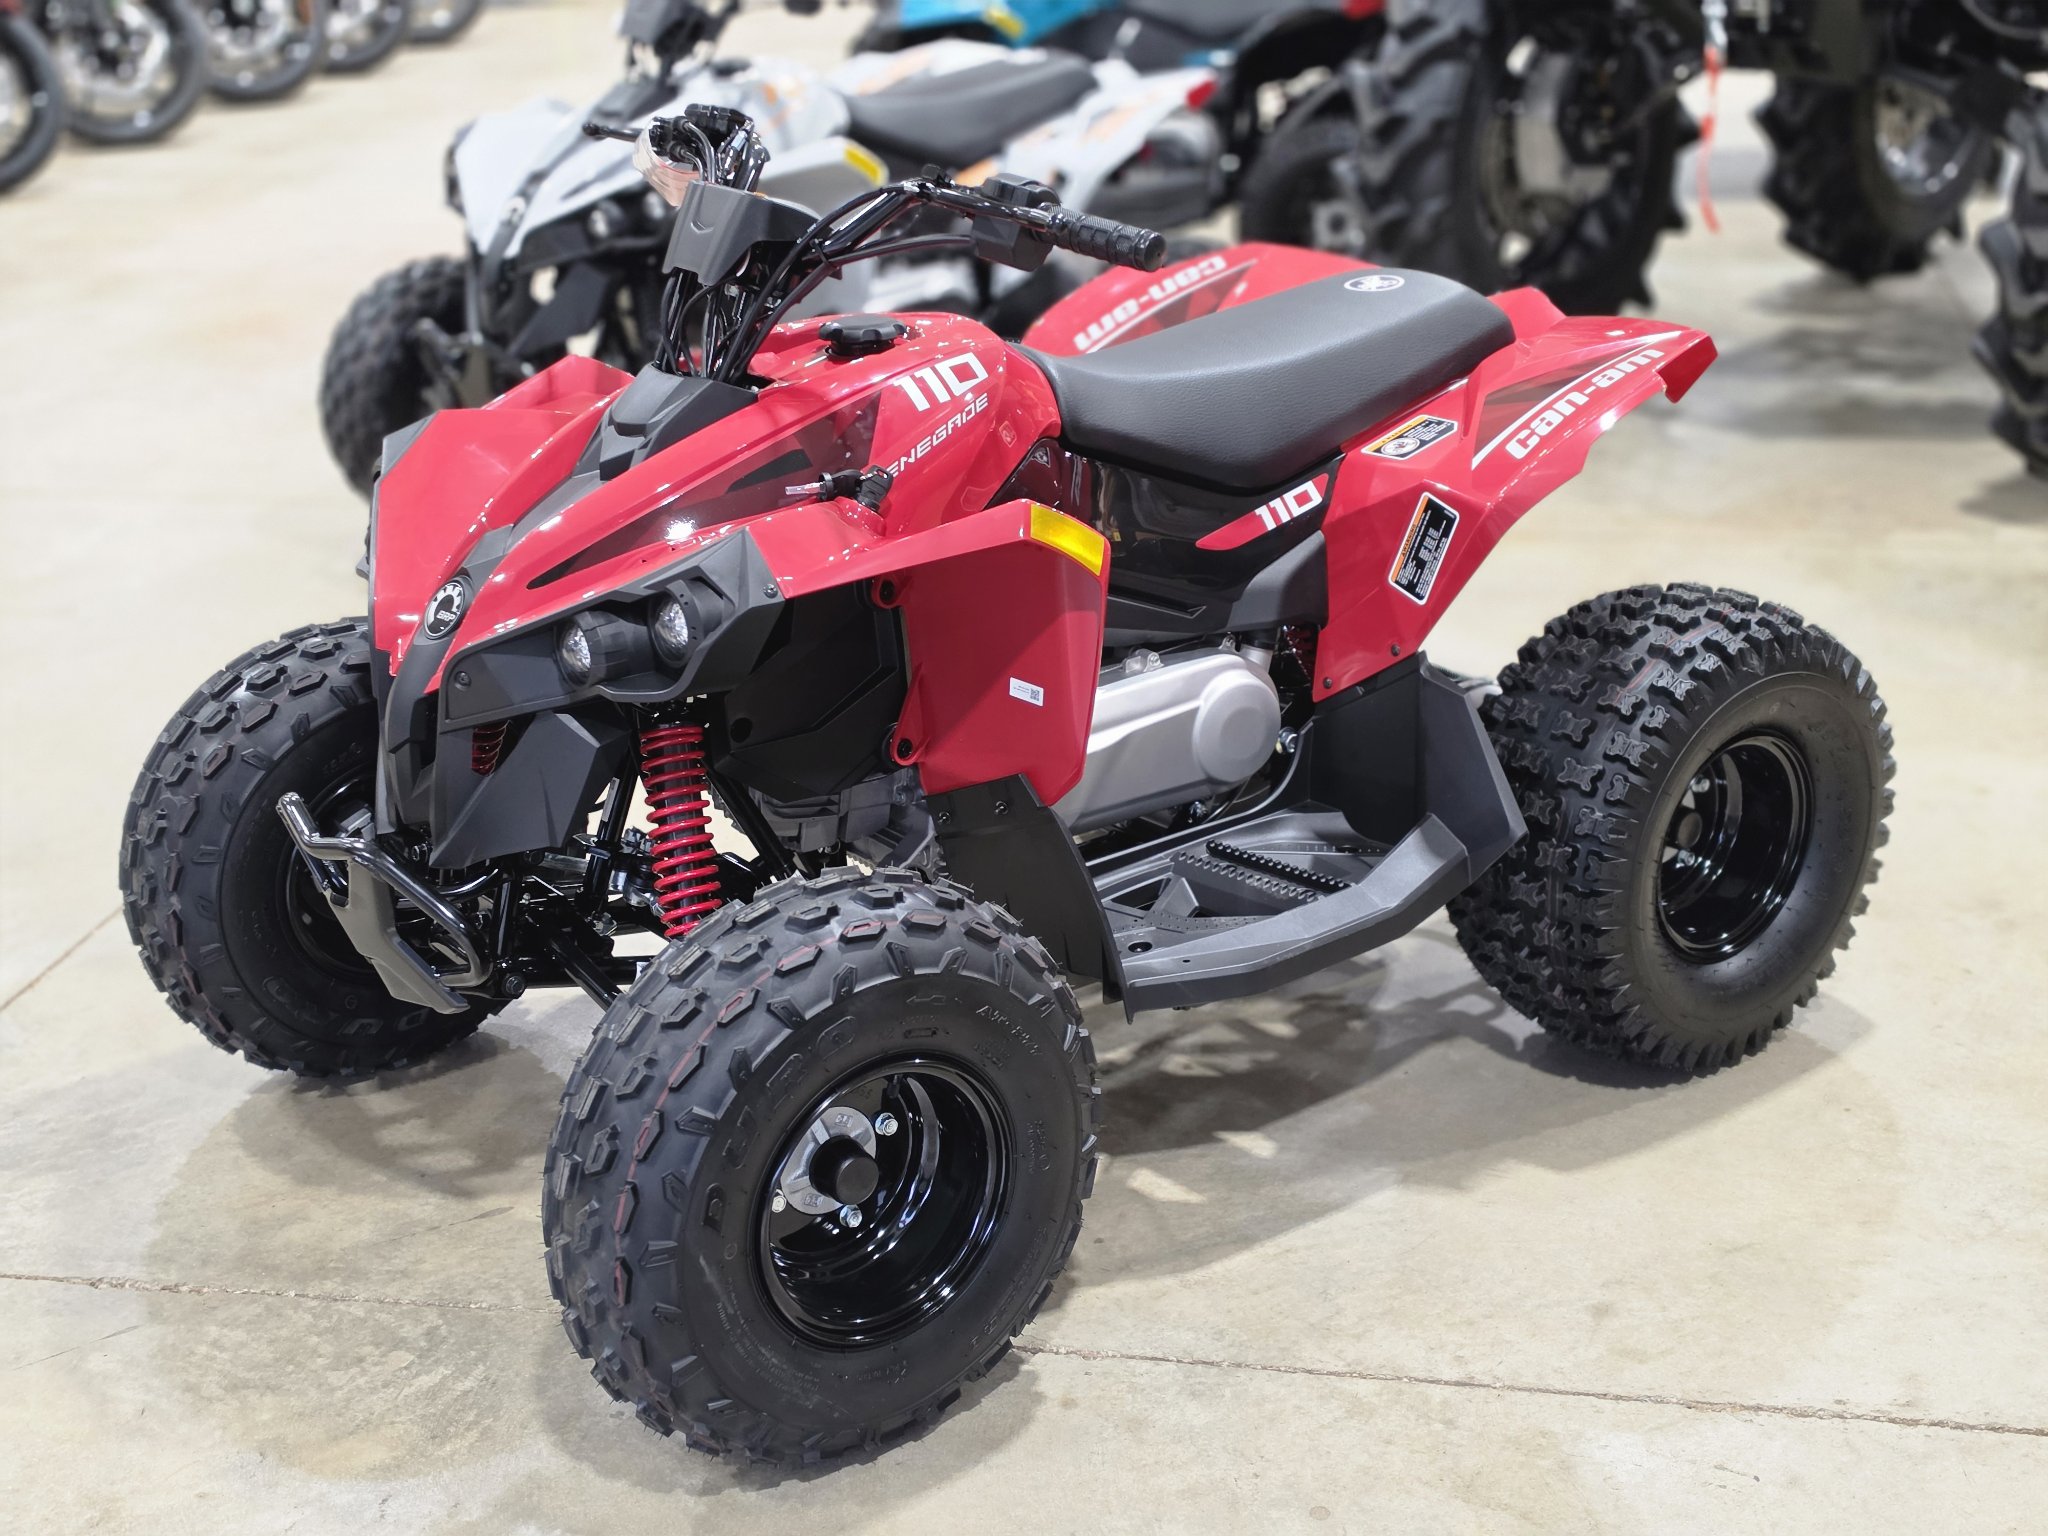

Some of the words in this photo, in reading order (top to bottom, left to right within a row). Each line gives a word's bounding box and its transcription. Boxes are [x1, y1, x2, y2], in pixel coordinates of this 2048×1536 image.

[893, 352, 989, 412] 110
[1505, 349, 1665, 459] can-am
[886, 392, 989, 478] ENEGADE
[1254, 480, 1323, 531] 110
[436, 610, 456, 621] BRP
